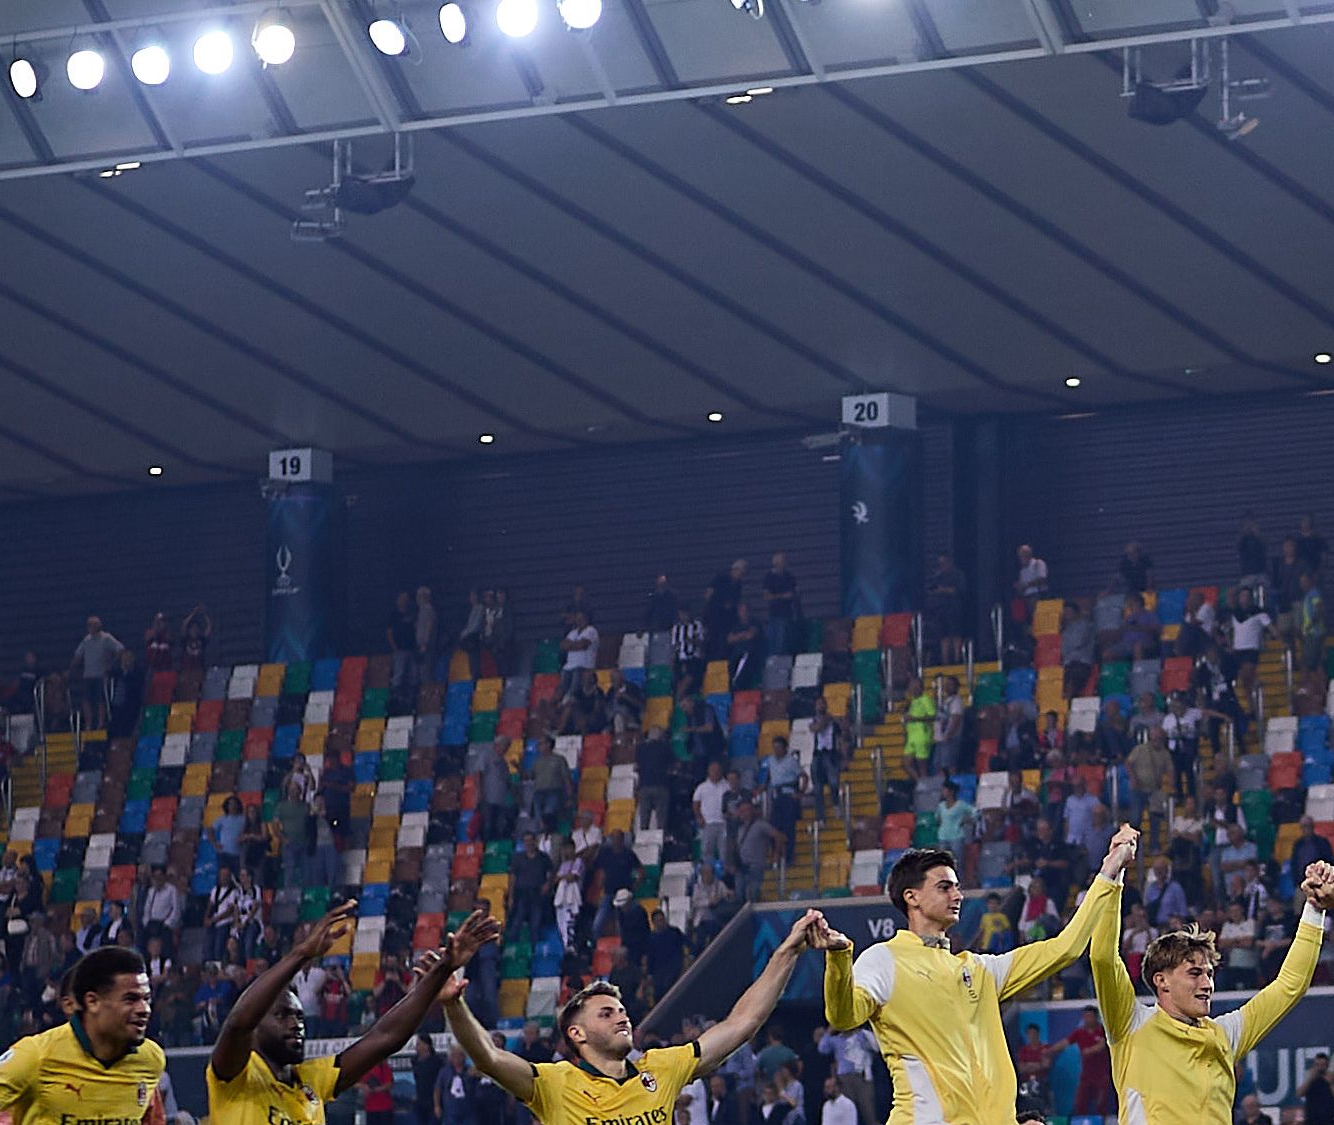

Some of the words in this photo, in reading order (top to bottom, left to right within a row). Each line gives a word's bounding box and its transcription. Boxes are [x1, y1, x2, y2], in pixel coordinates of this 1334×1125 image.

[853, 402, 879, 422] 20
[279, 456, 302, 476] 19
[868, 918, 895, 939] V8
